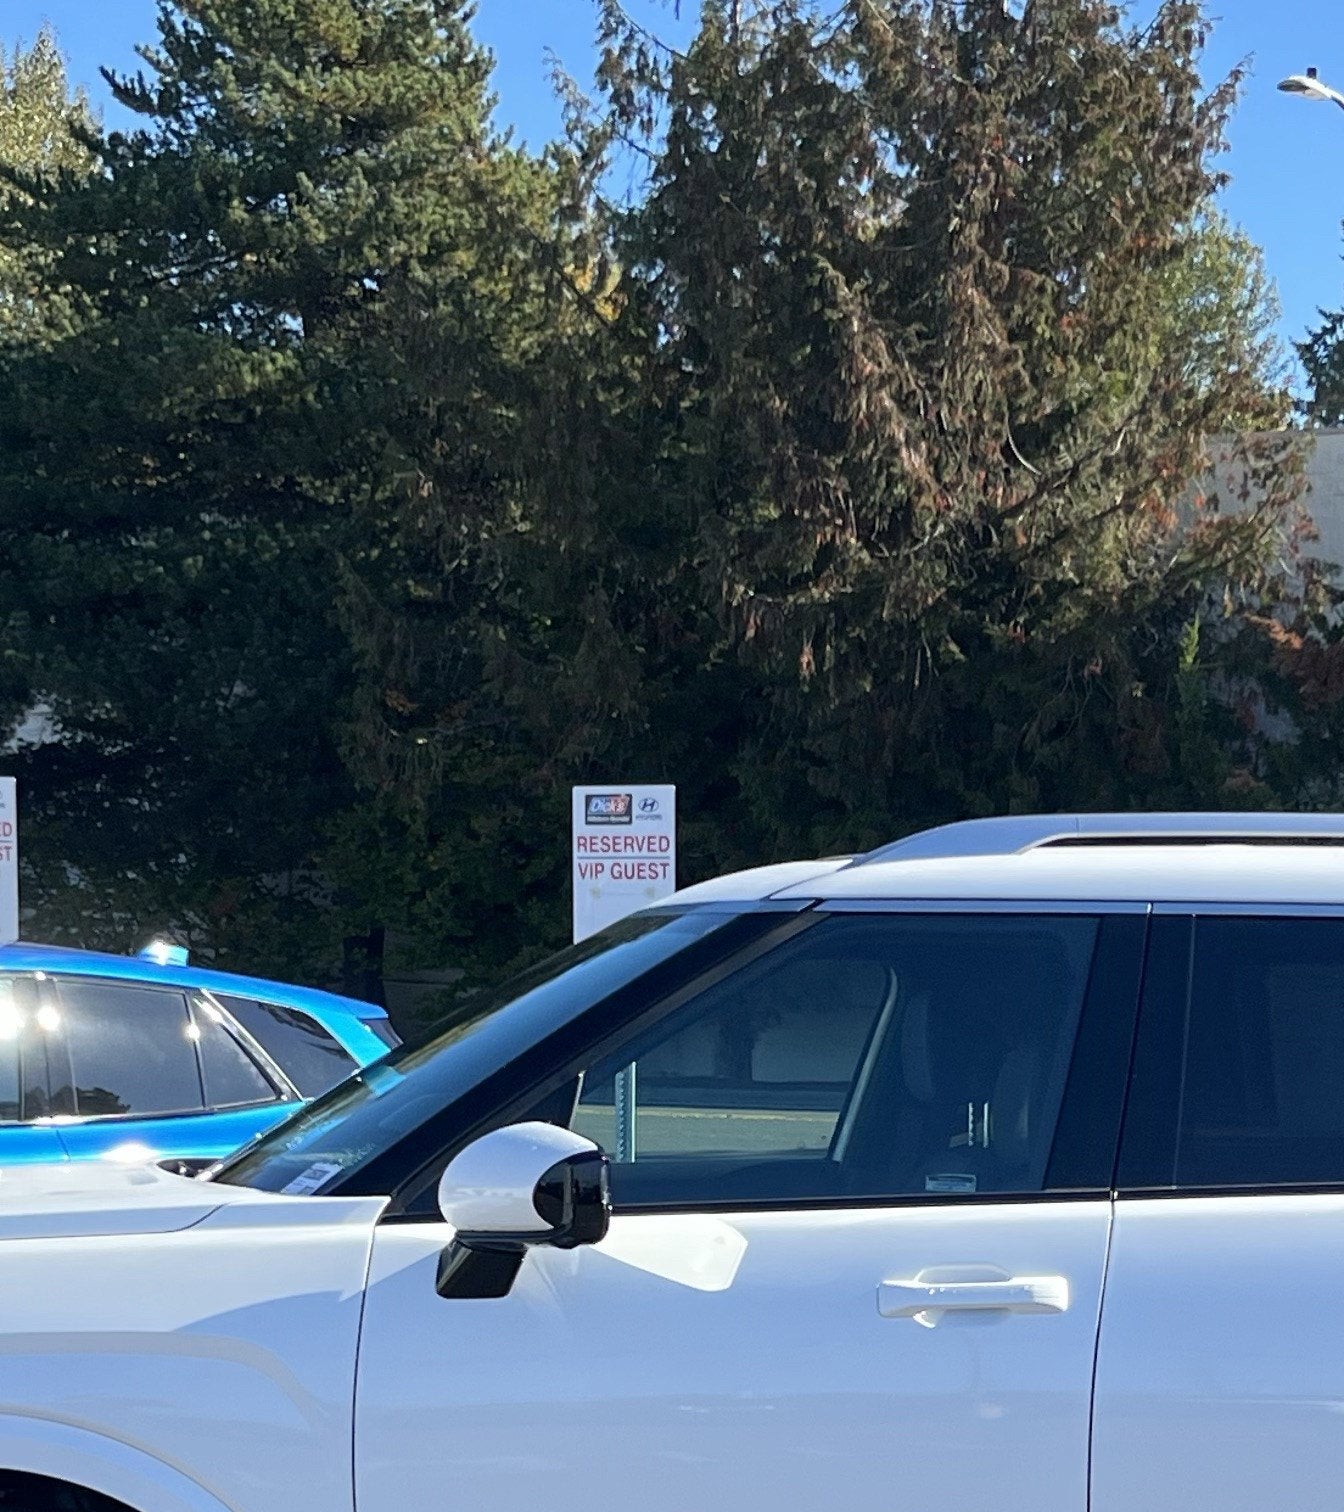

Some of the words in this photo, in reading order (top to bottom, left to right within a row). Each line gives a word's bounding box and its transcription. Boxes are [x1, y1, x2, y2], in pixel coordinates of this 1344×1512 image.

[577, 835, 671, 853] RESERVED
[578, 862, 605, 880] VIP
[610, 862, 670, 880] GUEST
